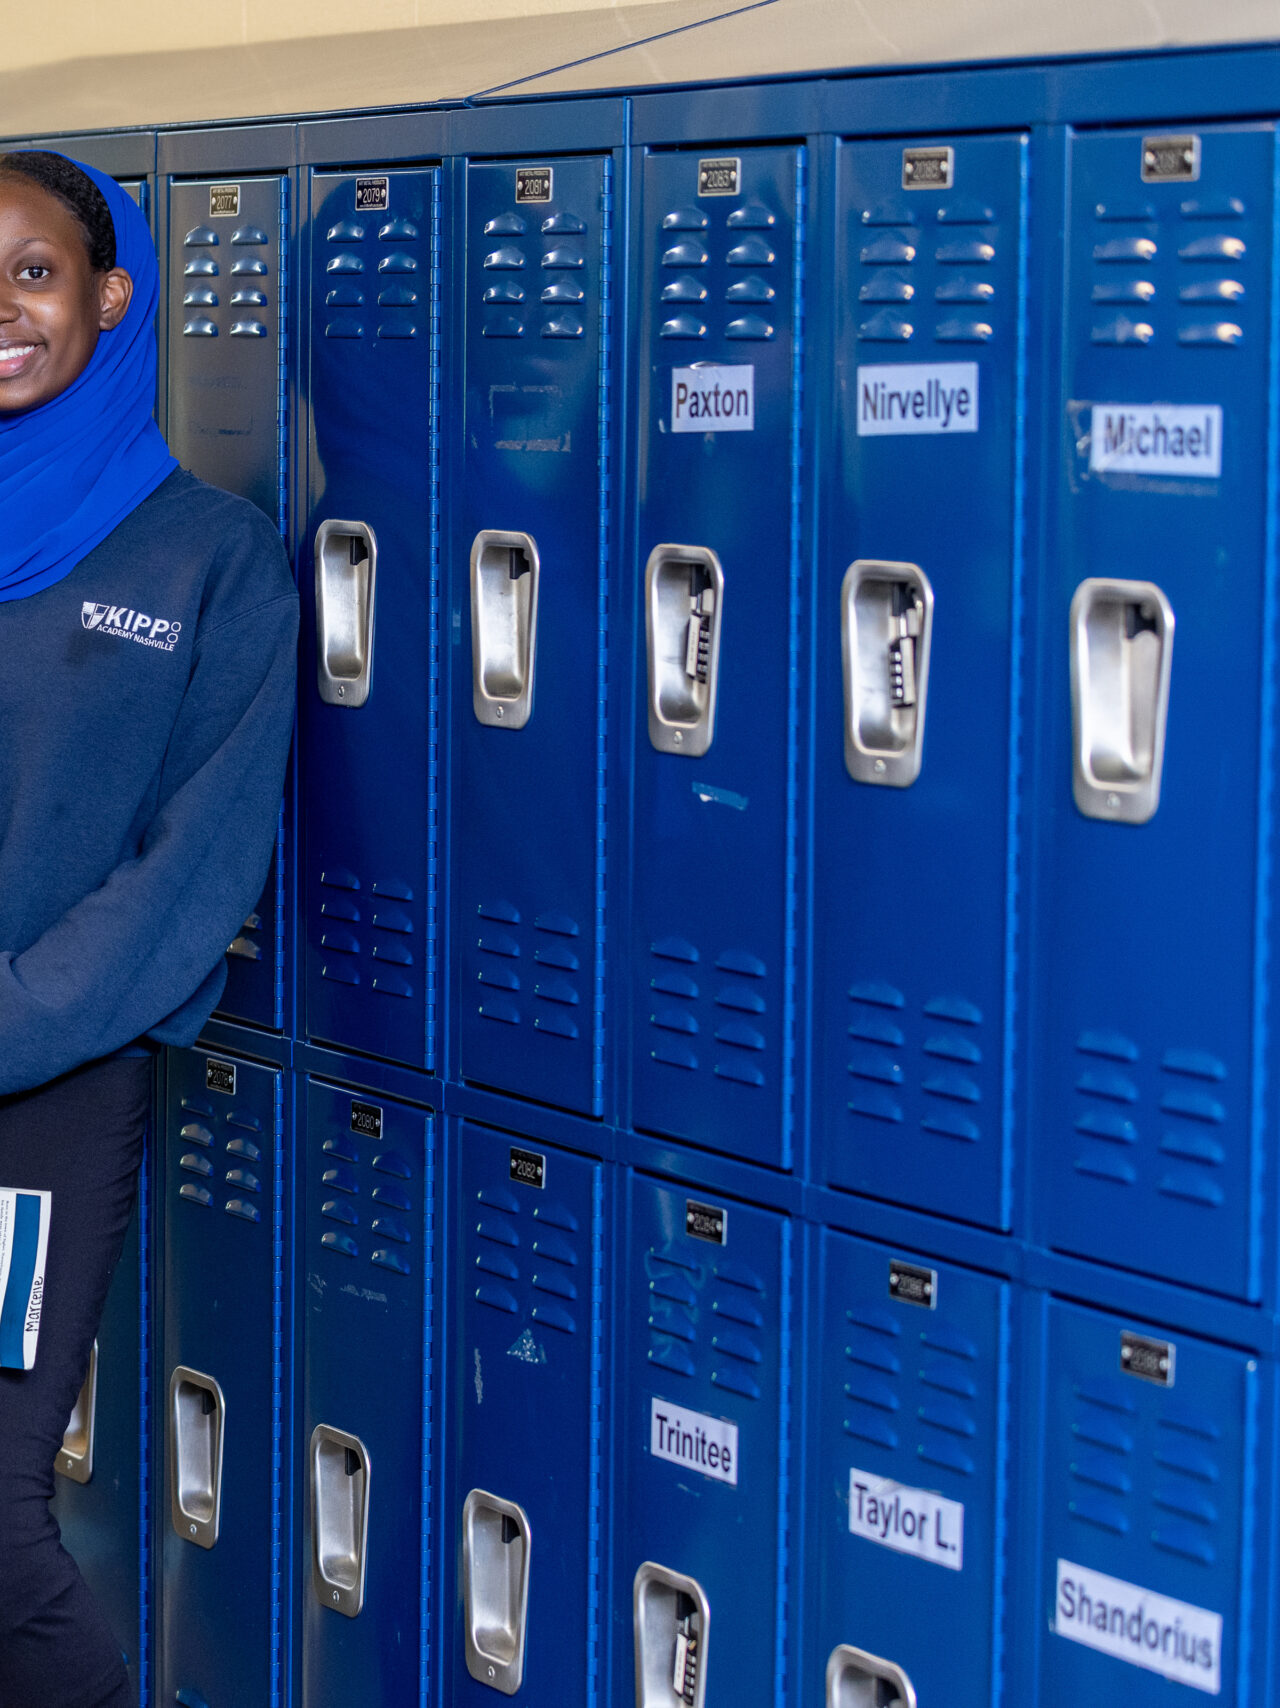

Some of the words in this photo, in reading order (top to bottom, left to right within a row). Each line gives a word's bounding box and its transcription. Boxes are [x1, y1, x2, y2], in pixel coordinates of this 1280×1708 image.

[216, 195, 232, 210] 2077
[362, 187, 380, 203] 2079
[524, 179, 542, 195] 2081
[675, 382, 749, 418] Paxton
[862, 378, 971, 427] Nirvellye
[1104, 414, 1213, 458] Michael
[96, 623, 135, 641] ACADEMY
[133, 632, 175, 652] NASHVILLE
[105, 605, 170, 639] KIPP
[357, 1112, 375, 1130] 2080
[517, 1159, 536, 1180] 2082
[24, 1276, 43, 1332] Marcelle
[655, 1412, 731, 1474] Trinitee
[853, 1481, 928, 1542] Taylor
[935, 1520, 958, 1553] L.
[1058, 1576, 1215, 1670] Shandorius
